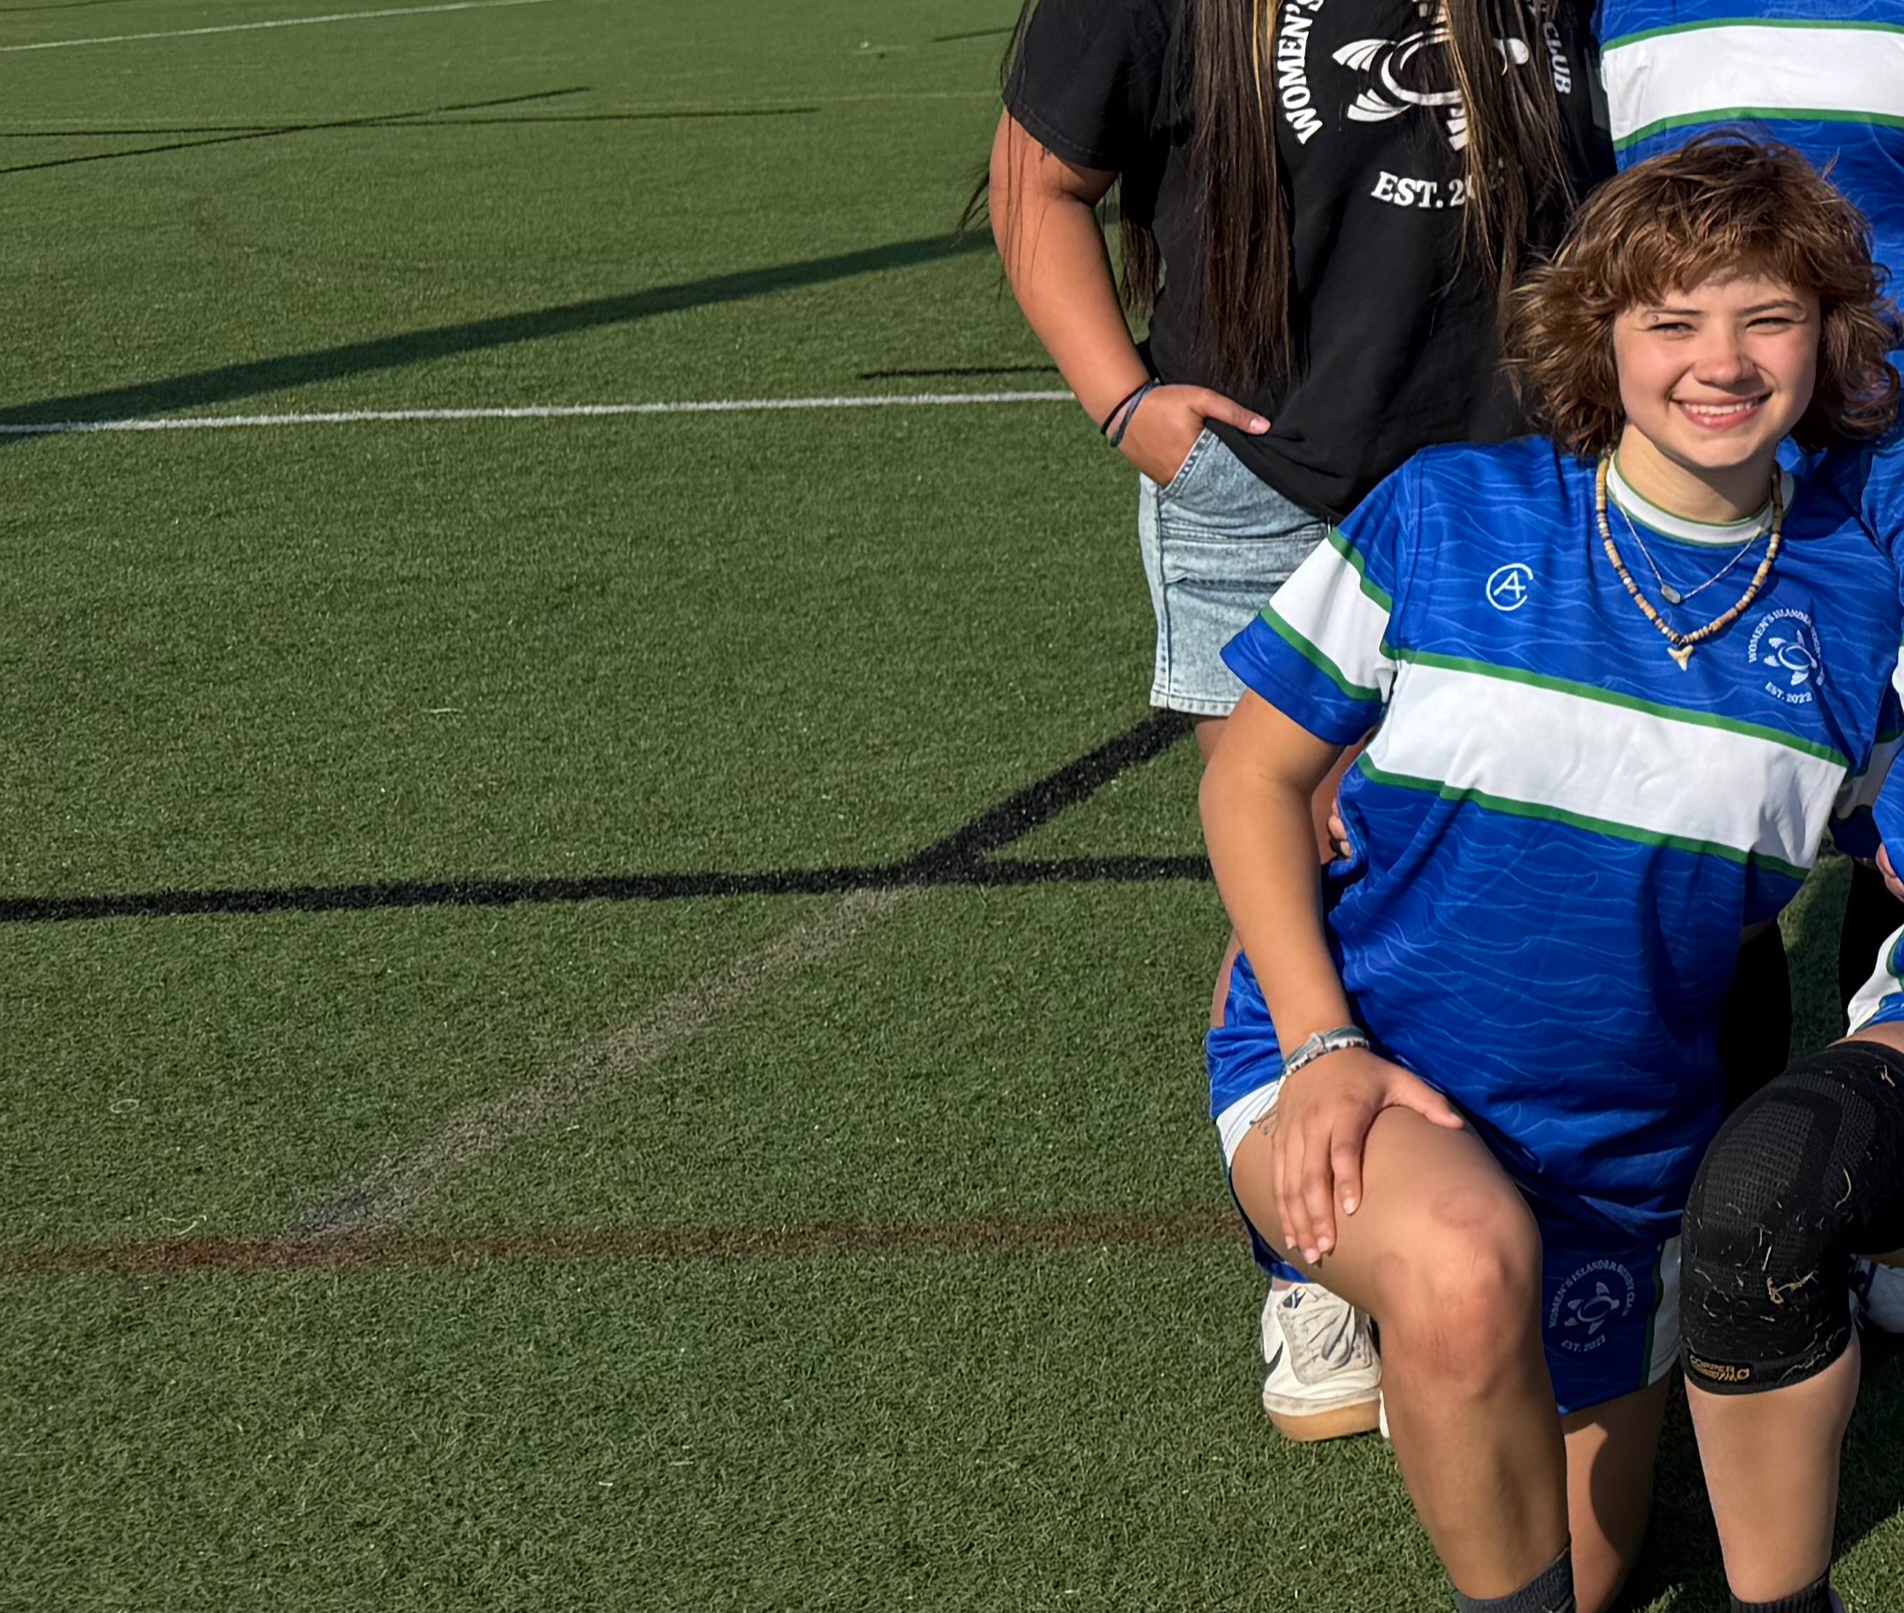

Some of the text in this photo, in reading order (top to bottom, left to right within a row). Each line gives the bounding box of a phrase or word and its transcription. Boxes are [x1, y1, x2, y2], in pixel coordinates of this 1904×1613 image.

[1371, 171, 1443, 208] EST.
[1748, 613, 1775, 664] WOMEN'S
[1765, 681, 1813, 704] EST. 2022
